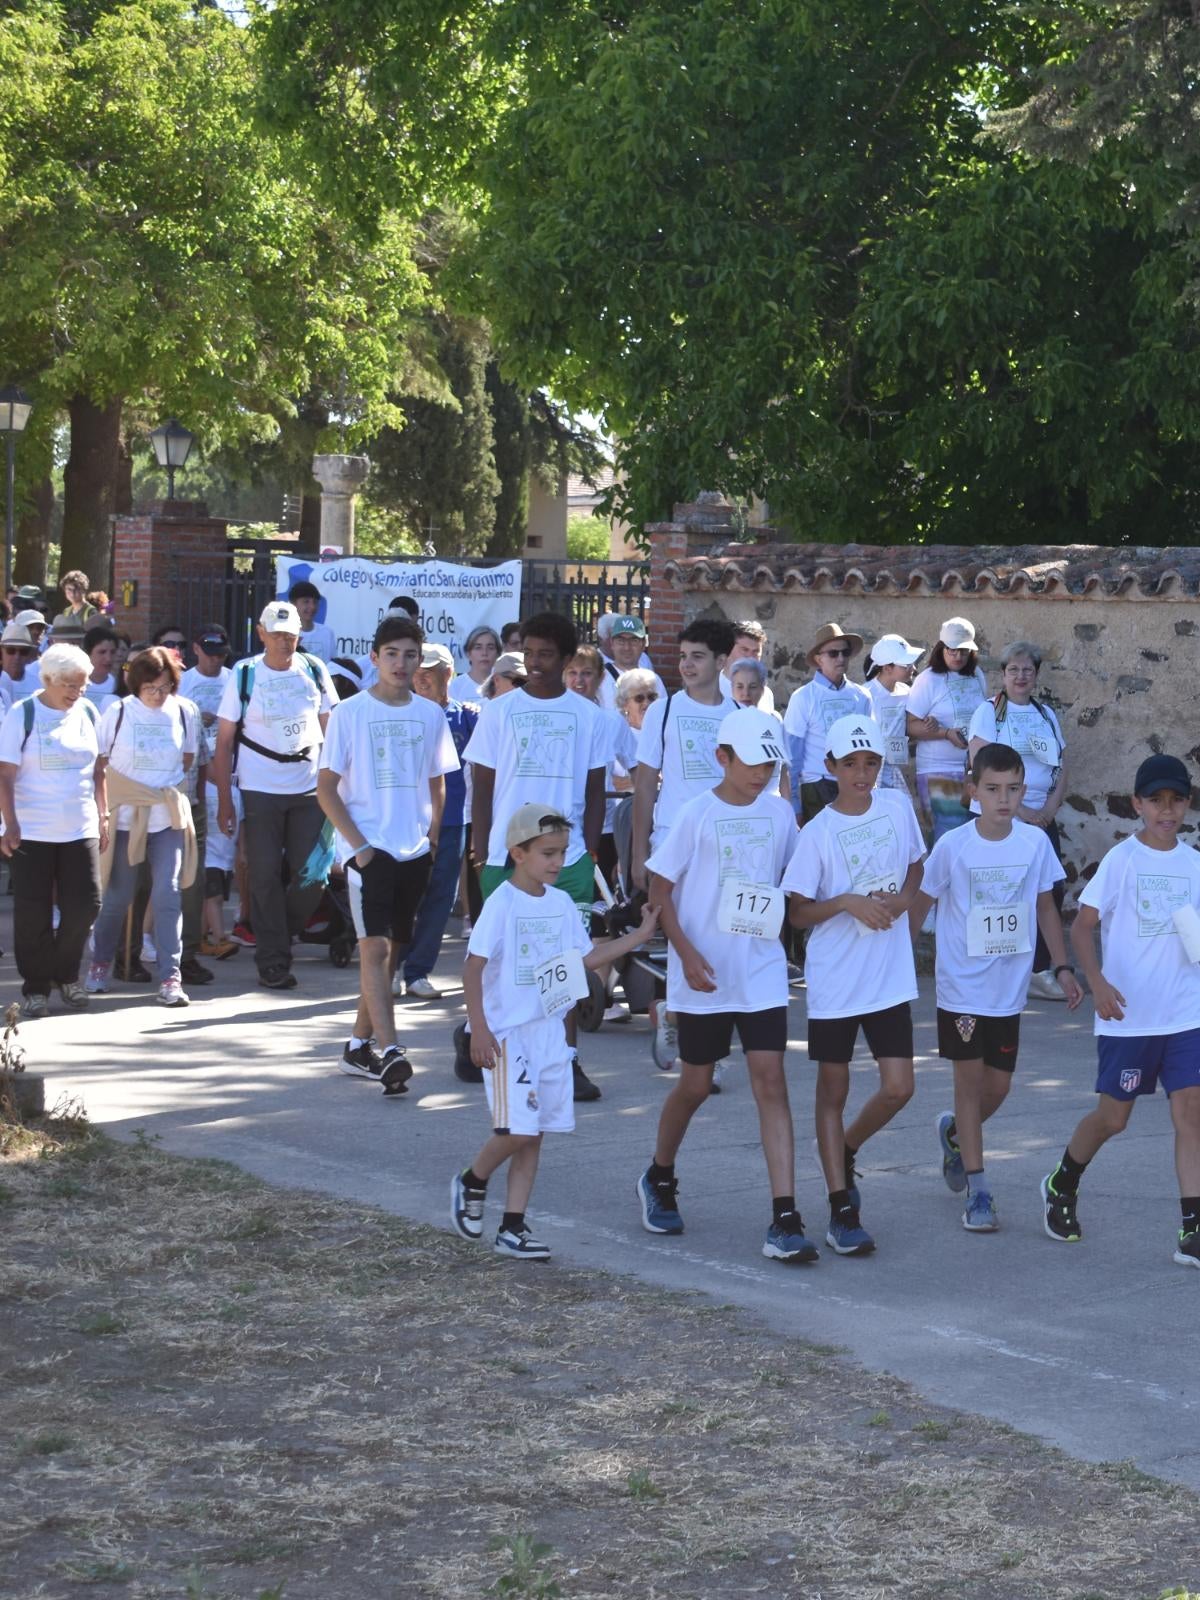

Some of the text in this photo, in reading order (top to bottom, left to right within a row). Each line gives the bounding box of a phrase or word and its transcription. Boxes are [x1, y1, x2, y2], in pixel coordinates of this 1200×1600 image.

[436, 568, 456, 586] San
[438, 610, 456, 634] de
[736, 892, 771, 914] 117
[984, 914, 1018, 934] 119
[538, 964, 568, 994] 276
[516, 1056, 532, 1084] 2
